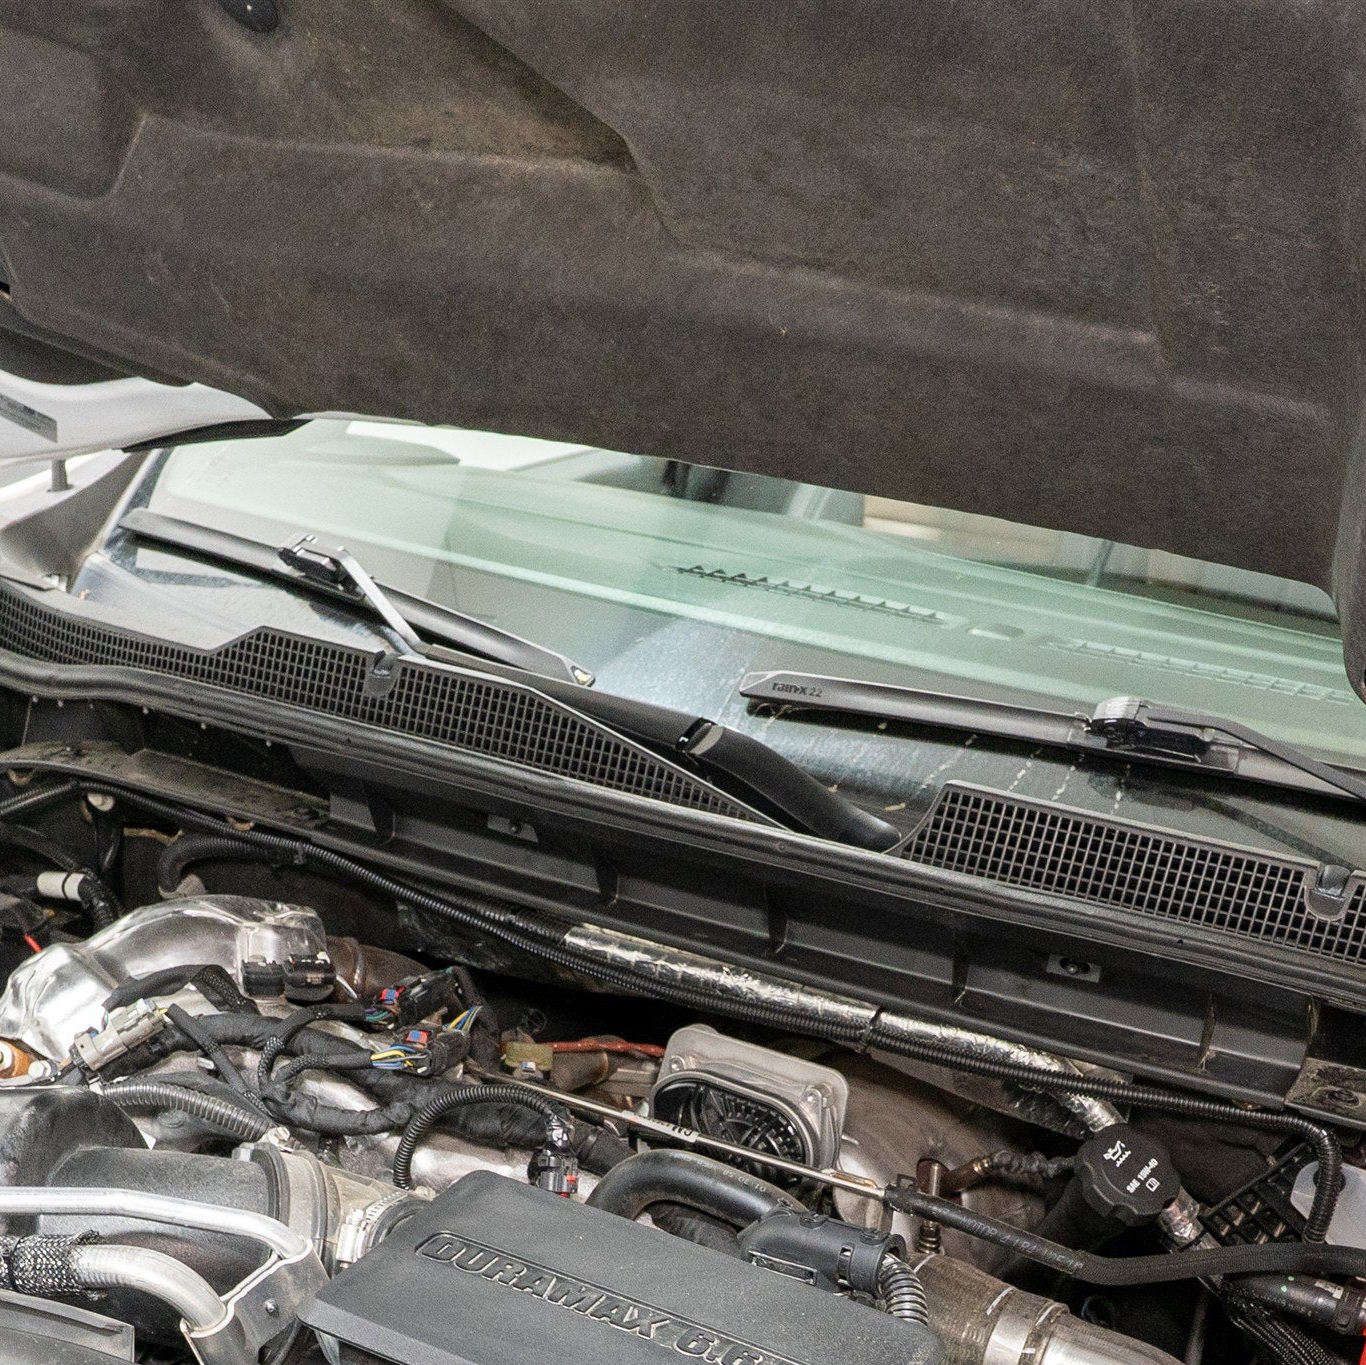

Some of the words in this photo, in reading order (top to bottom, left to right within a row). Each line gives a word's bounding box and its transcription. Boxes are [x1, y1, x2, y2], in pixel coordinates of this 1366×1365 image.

[1126, 1178, 1141, 1194] SAE
[1137, 1158, 1159, 1181] 15W-40
[421, 1234, 669, 1339] DURAMAX
